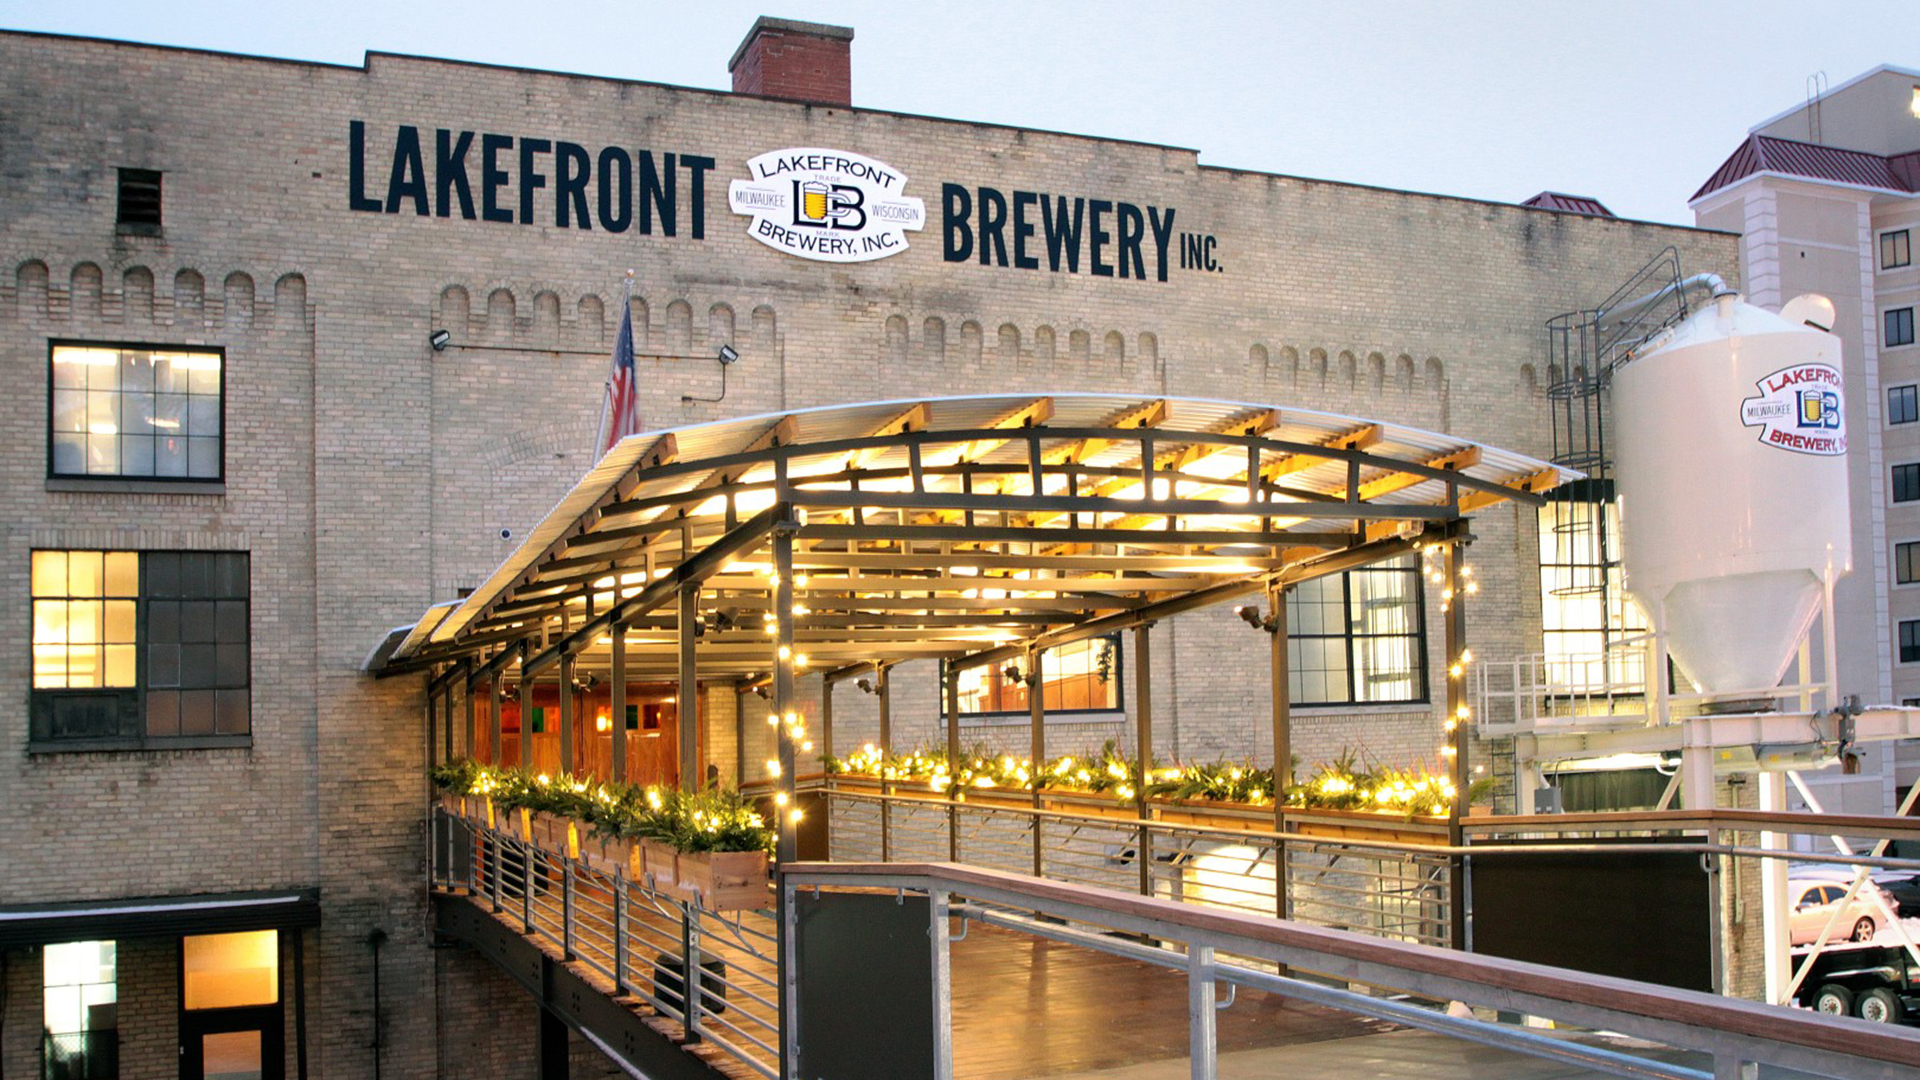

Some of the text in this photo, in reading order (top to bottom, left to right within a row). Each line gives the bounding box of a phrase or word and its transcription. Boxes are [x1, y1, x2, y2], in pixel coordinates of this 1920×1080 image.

[759, 156, 896, 188] LAKEFRONT
[814, 174, 841, 182] TRADE
[350, 120, 1224, 282] LAKEFRONT BREWERY INC.
[735, 190, 785, 208] MILWAUKEE
[872, 204, 919, 221] WISCONSIN
[758, 219, 899, 256] BREWERY, INC.
[816, 230, 840, 238] MARK
[1767, 368, 1843, 392] LAKEFRO
[1747, 404, 1791, 418] MILWAUKEE
[1769, 429, 1837, 453] BREWERY,
